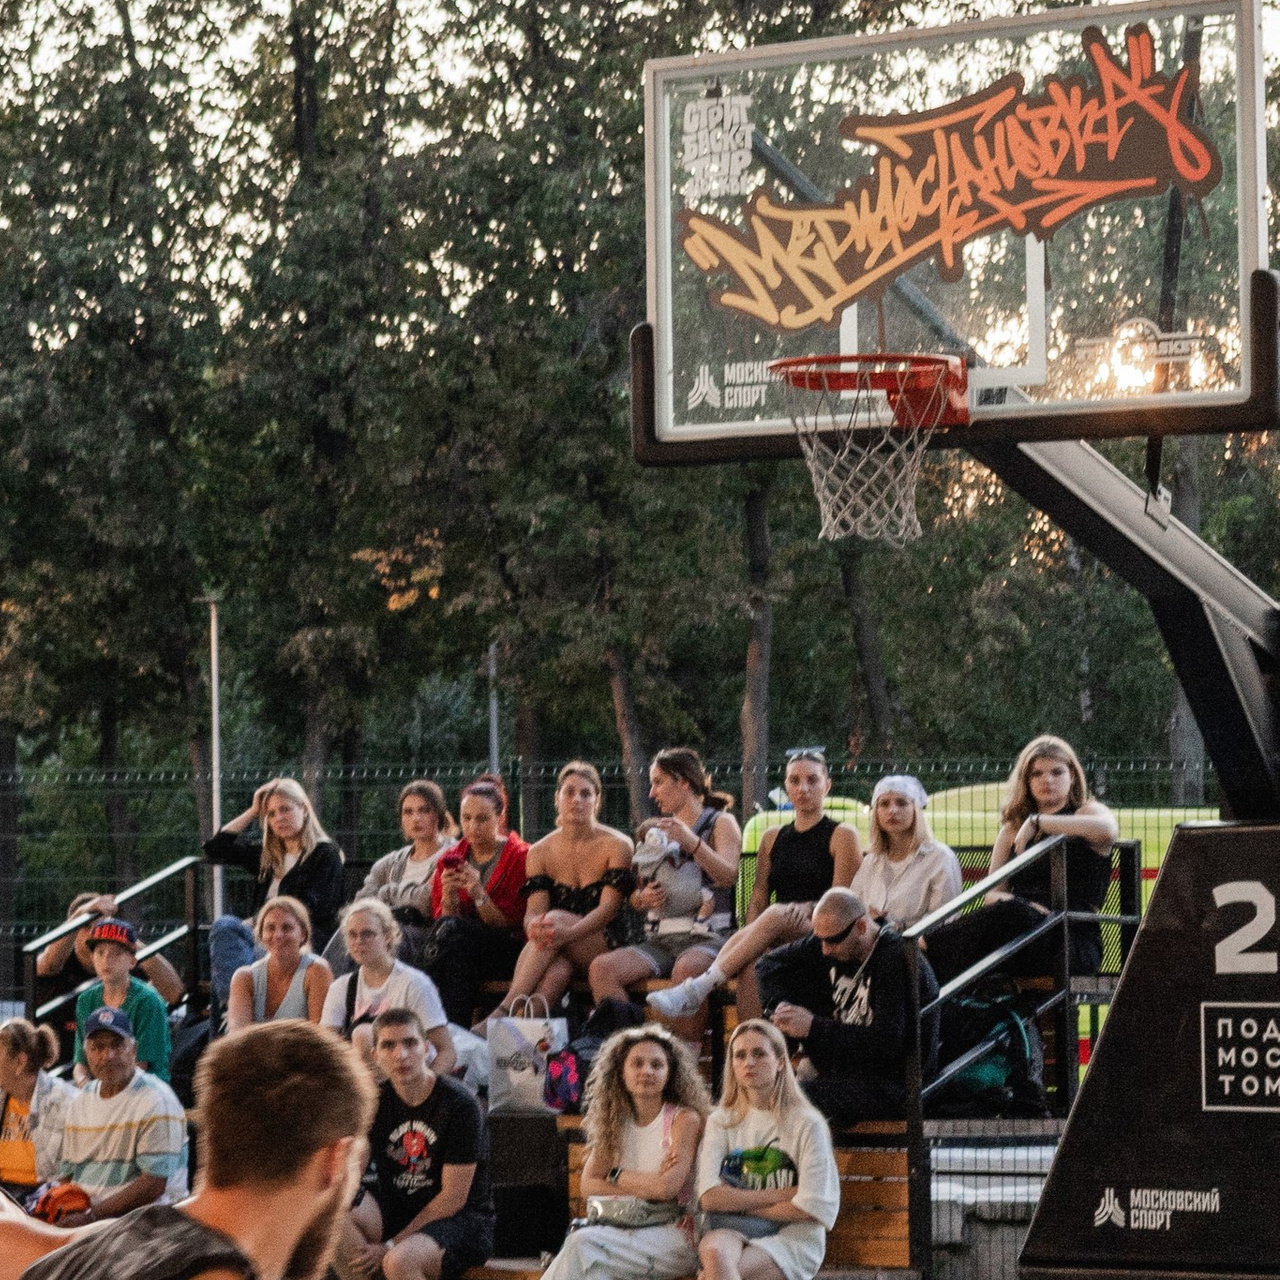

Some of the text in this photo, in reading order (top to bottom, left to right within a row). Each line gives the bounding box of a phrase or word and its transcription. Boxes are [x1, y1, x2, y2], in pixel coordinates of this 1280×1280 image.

[724, 384, 768, 410] СПОРТ
[1212, 880, 1278, 974] 2
[1217, 1017, 1280, 1044] ПОД
[1130, 1188, 1220, 1213] МОСКОВСКИЙ
[1130, 1210, 1172, 1231] СПОРТ
